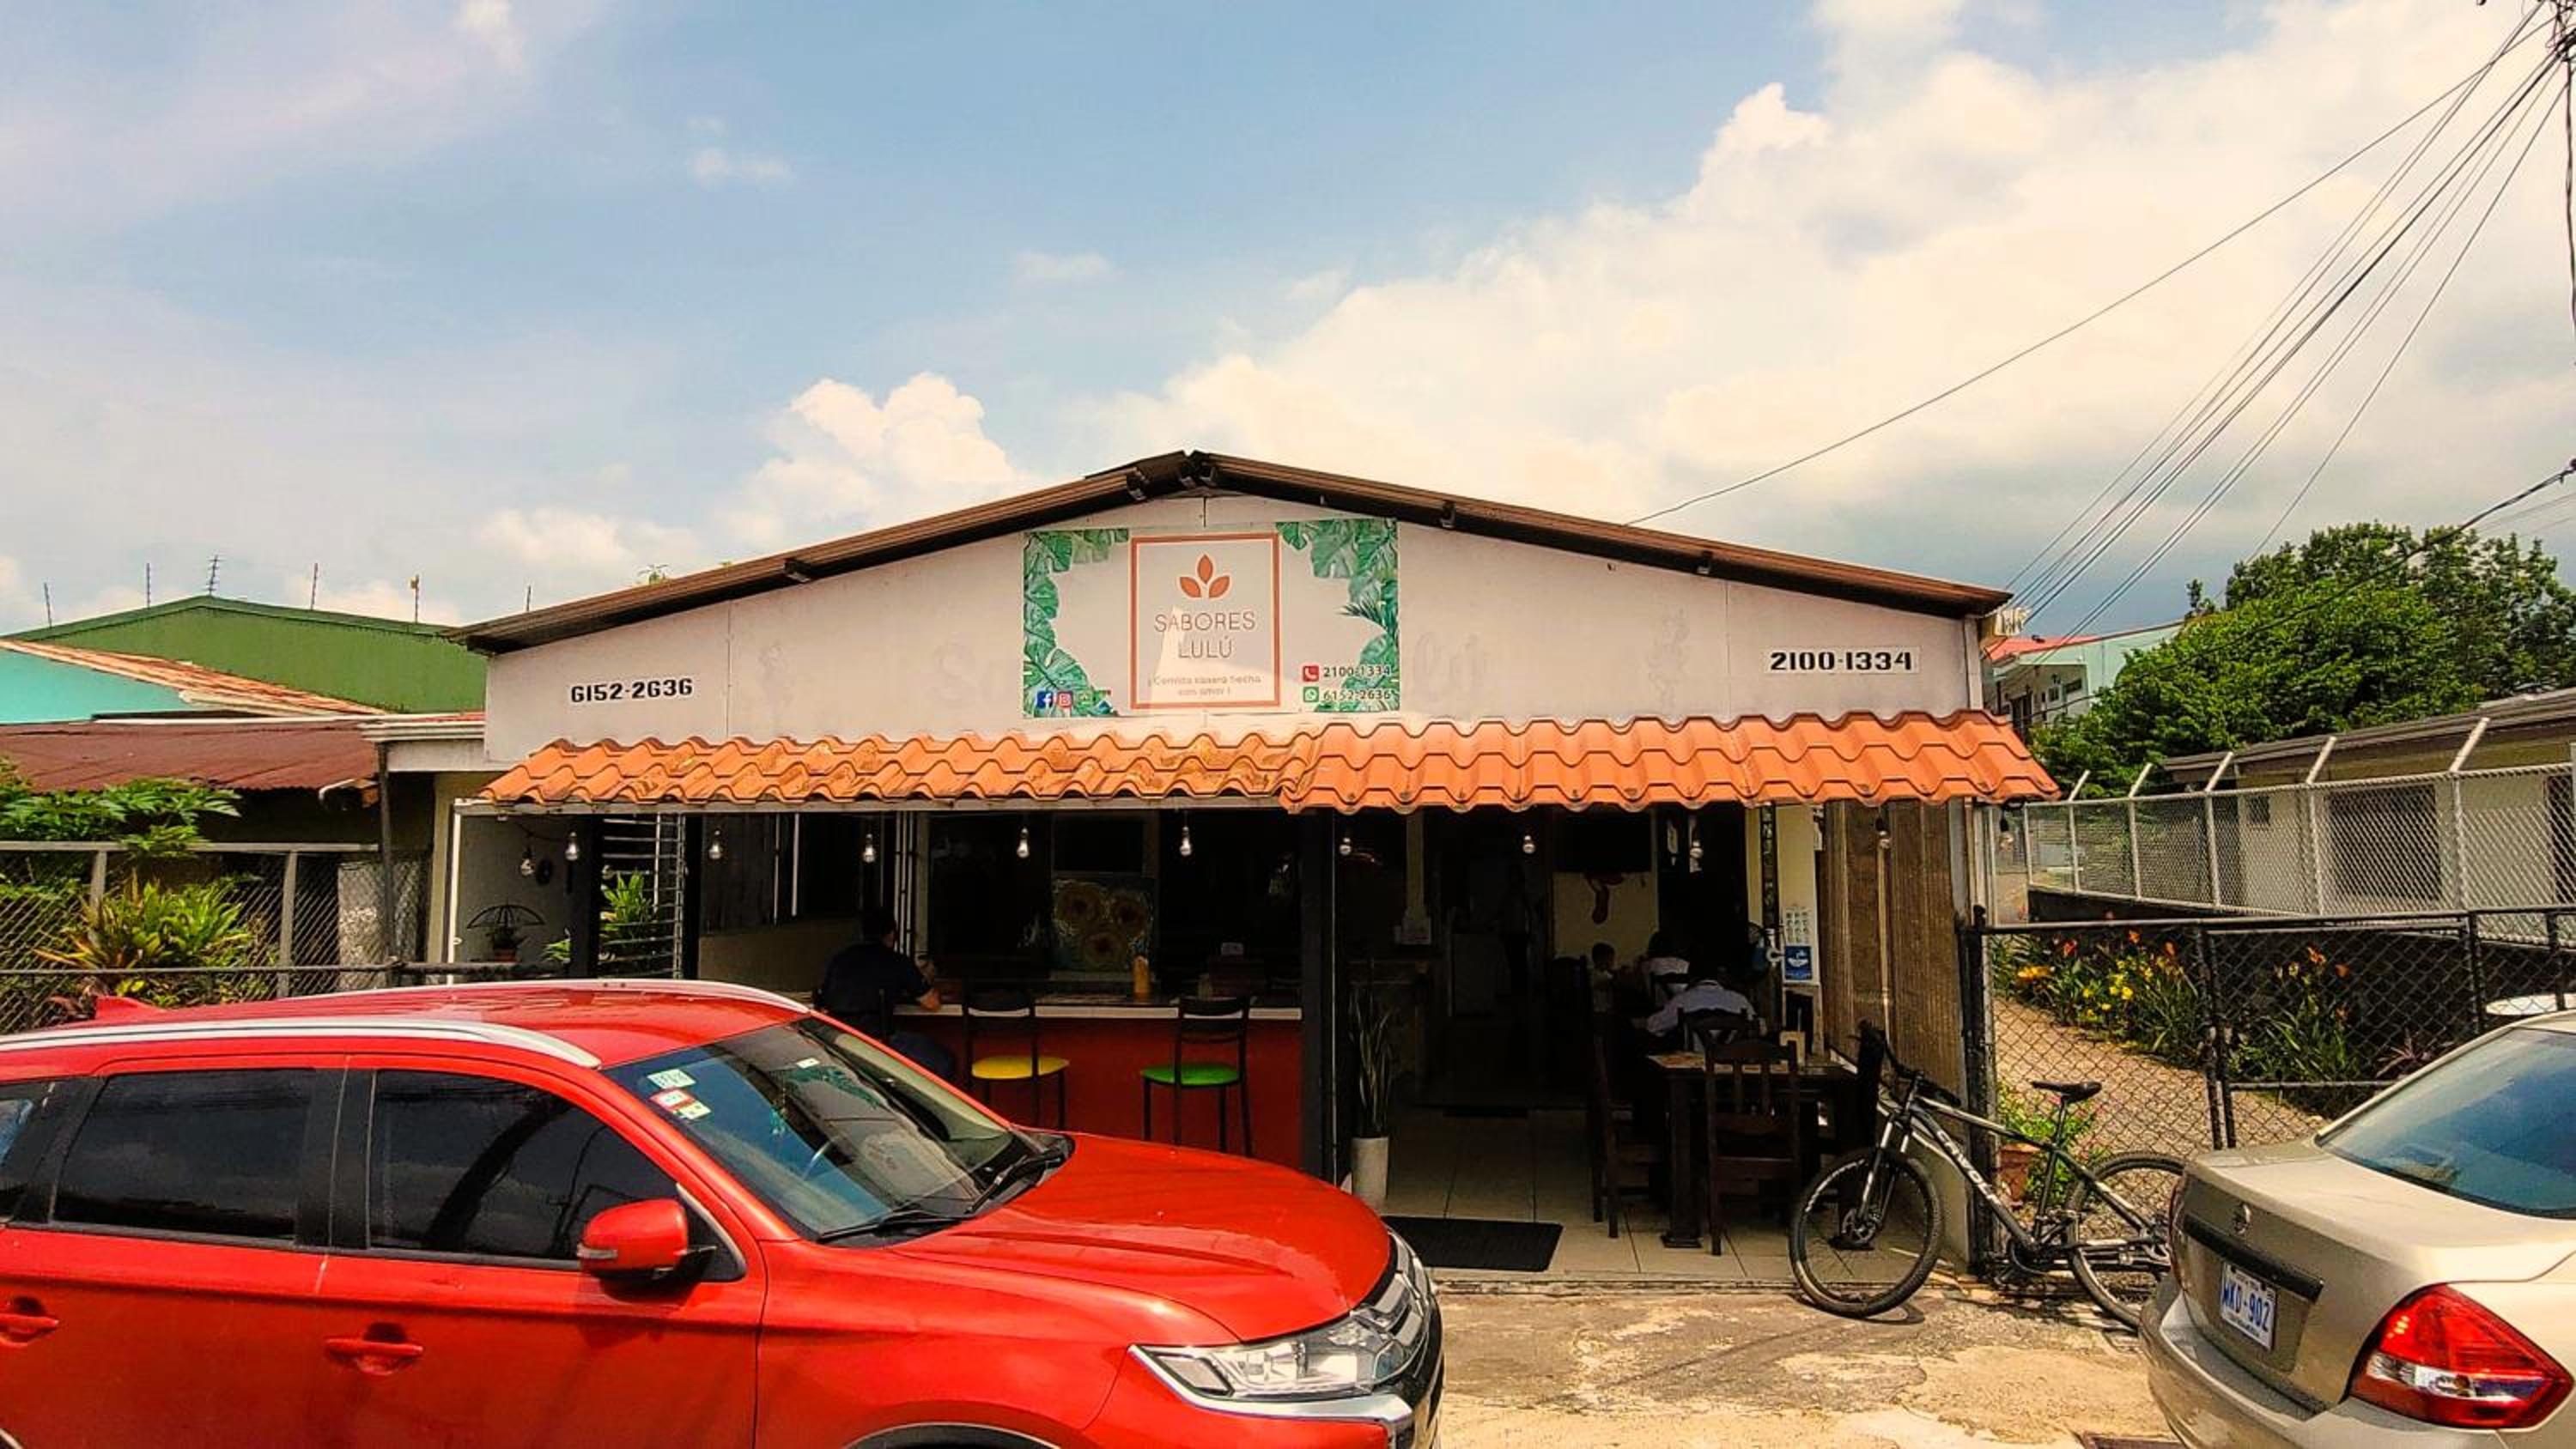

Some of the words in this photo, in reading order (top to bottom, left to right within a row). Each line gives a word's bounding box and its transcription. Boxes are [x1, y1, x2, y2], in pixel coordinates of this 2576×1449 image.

[1154, 610, 1255, 633] SABORES
[1178, 635, 1232, 658] LULÚ
[1770, 652, 1911, 671] 2100-1334
[570, 677, 694, 703] 6152-2636
[1323, 689, 1391, 701] 6152-2636
